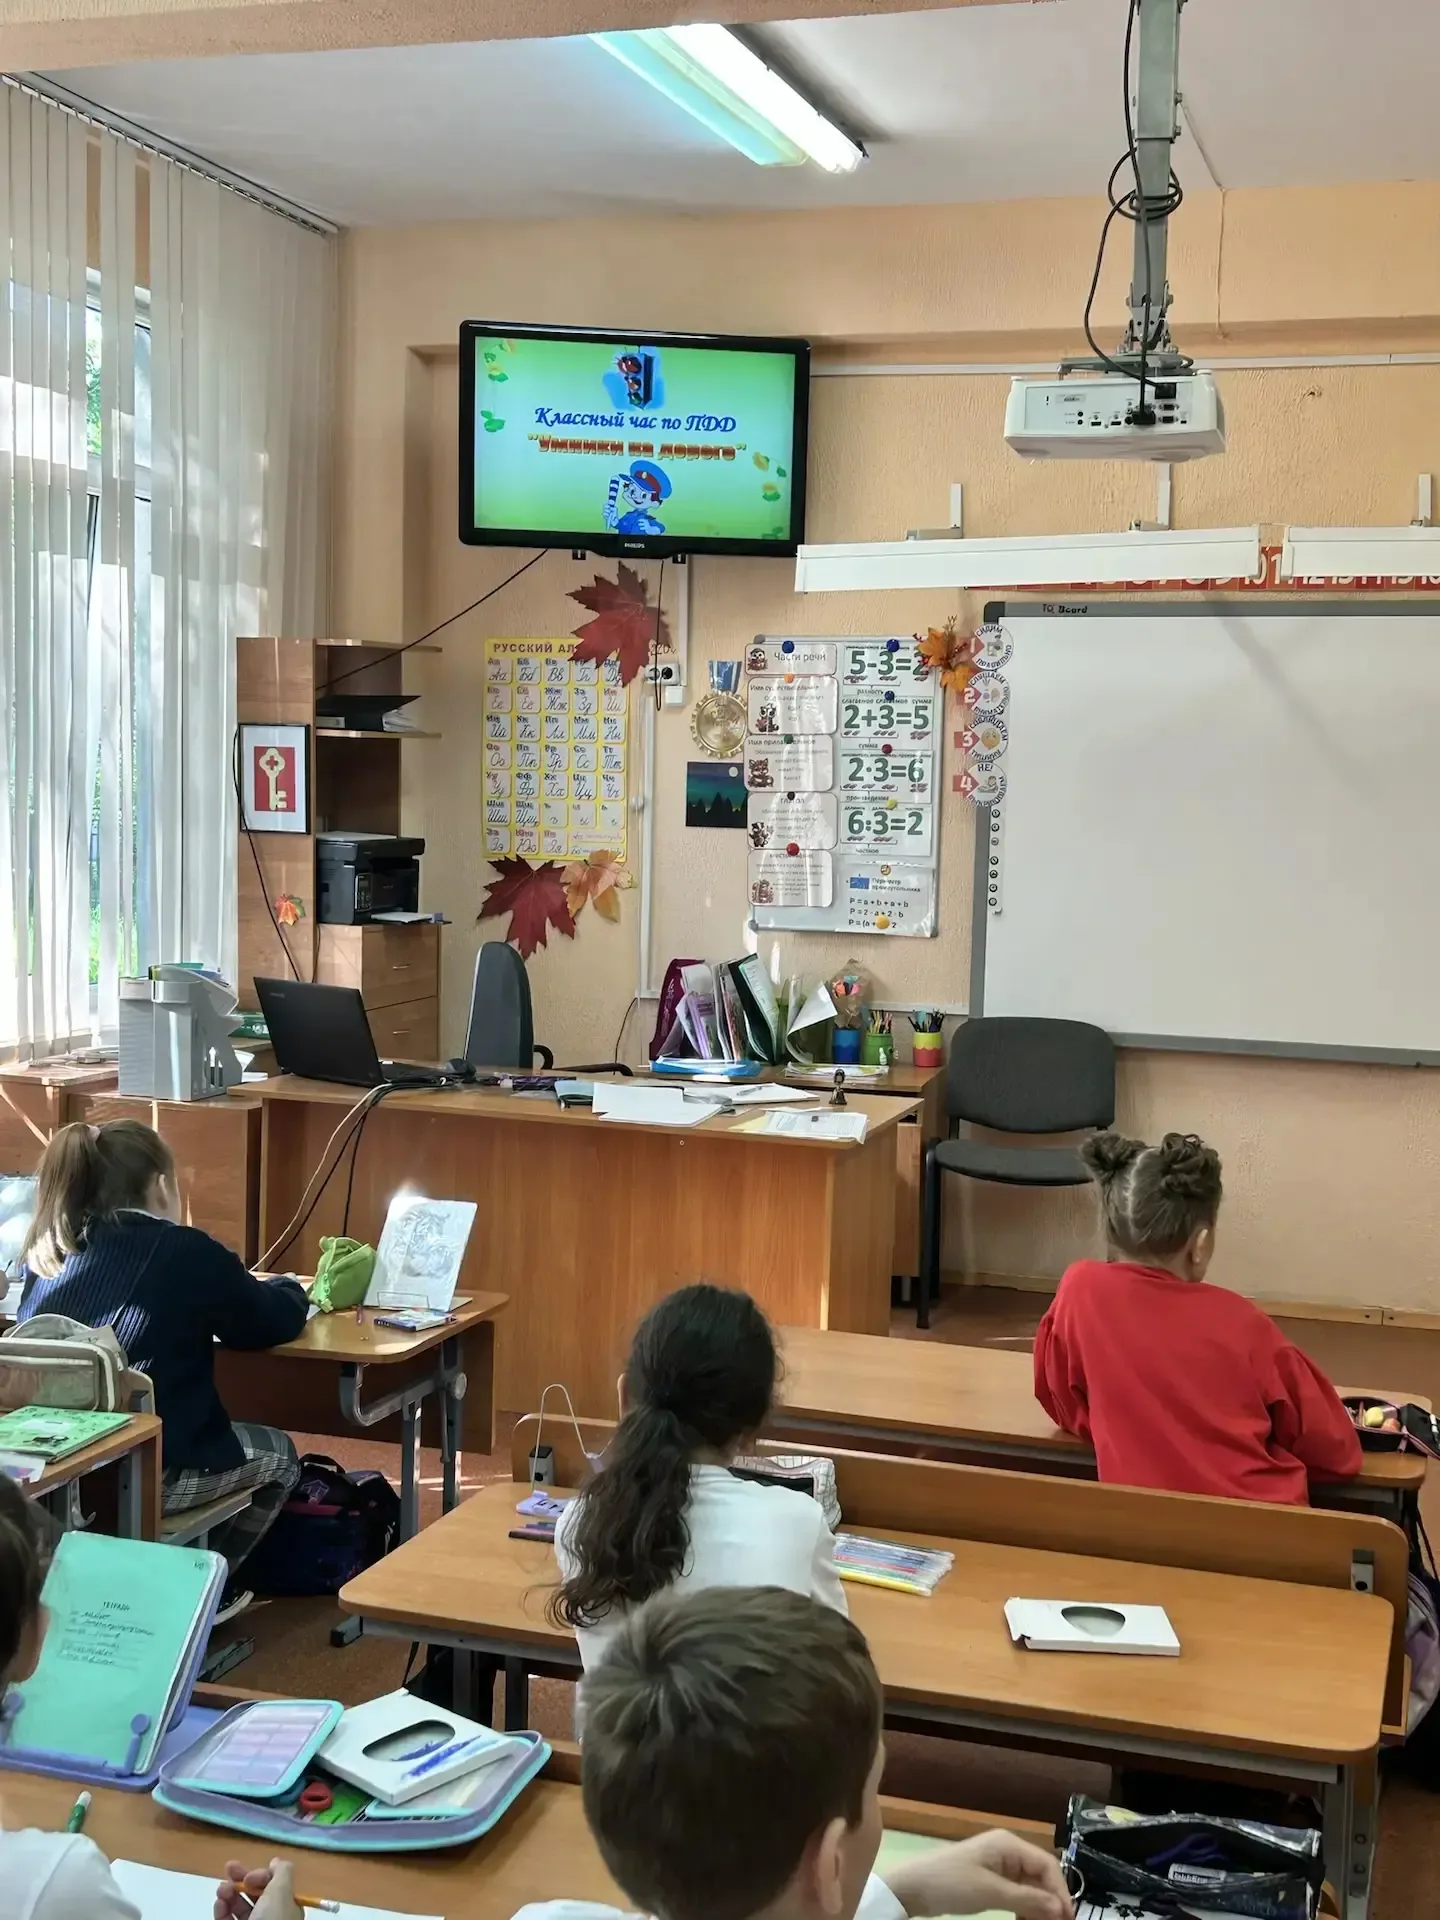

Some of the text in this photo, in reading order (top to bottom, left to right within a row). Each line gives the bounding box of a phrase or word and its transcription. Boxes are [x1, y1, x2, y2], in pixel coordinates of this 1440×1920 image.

[535, 408, 737, 432] Классный час по ПДД
[493, 643, 553, 653] РУССКИЙ
[850, 650, 930, 676] 5-3=2
[964, 687, 975, 703] 2
[844, 704, 930, 730] 2+3=5
[962, 731, 974, 747] 3
[960, 776, 972, 791] 4
[848, 810, 923, 836] 6:3=2
